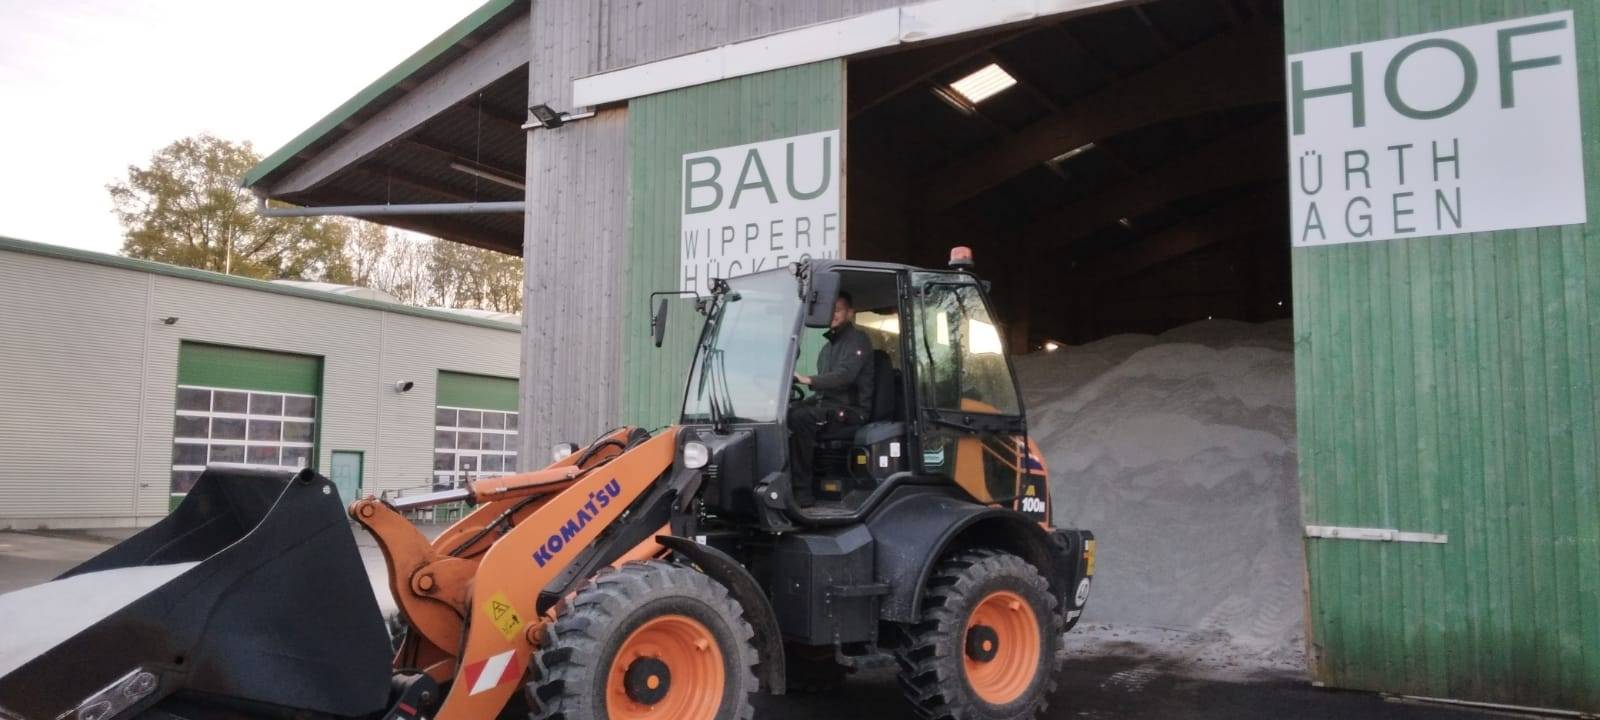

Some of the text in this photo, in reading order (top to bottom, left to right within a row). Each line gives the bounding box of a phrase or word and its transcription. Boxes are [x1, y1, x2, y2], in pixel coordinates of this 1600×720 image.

[685, 19, 1568, 215] BAU HOF
[684, 138, 1461, 260] WIPPERF ÜRTH
[1302, 187, 1463, 242] AGEN
[533, 478, 621, 568] KOMATSU
